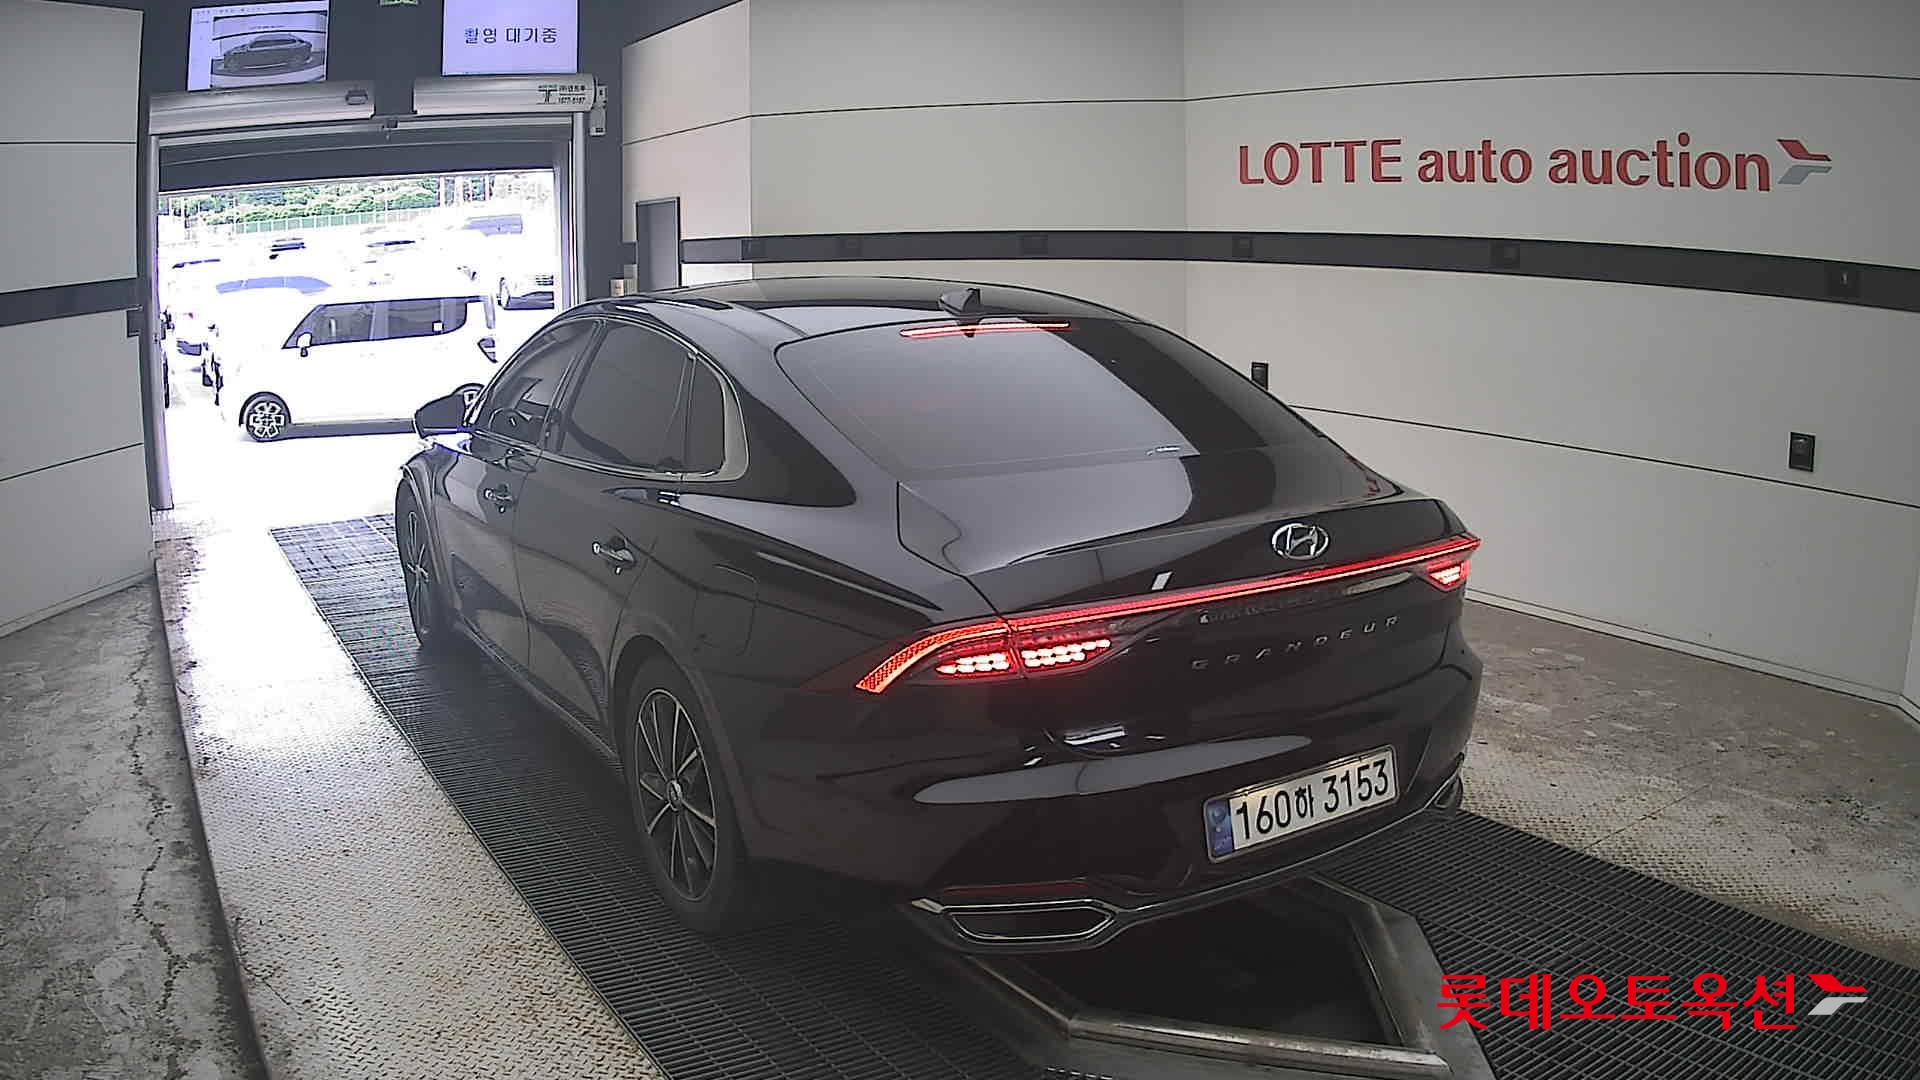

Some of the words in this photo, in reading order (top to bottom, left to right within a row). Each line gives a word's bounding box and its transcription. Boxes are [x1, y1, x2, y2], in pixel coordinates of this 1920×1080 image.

[464, 27, 497, 44] 촬영
[504, 27, 558, 44] 대기중
[1239, 138, 1402, 185] LOTTE
[1417, 139, 1533, 184] auto
[1548, 131, 1771, 192] auction
[1191, 615, 1398, 670] GRANDEUR
[1236, 786, 1314, 840] 160하
[1322, 759, 1390, 813] 3153
